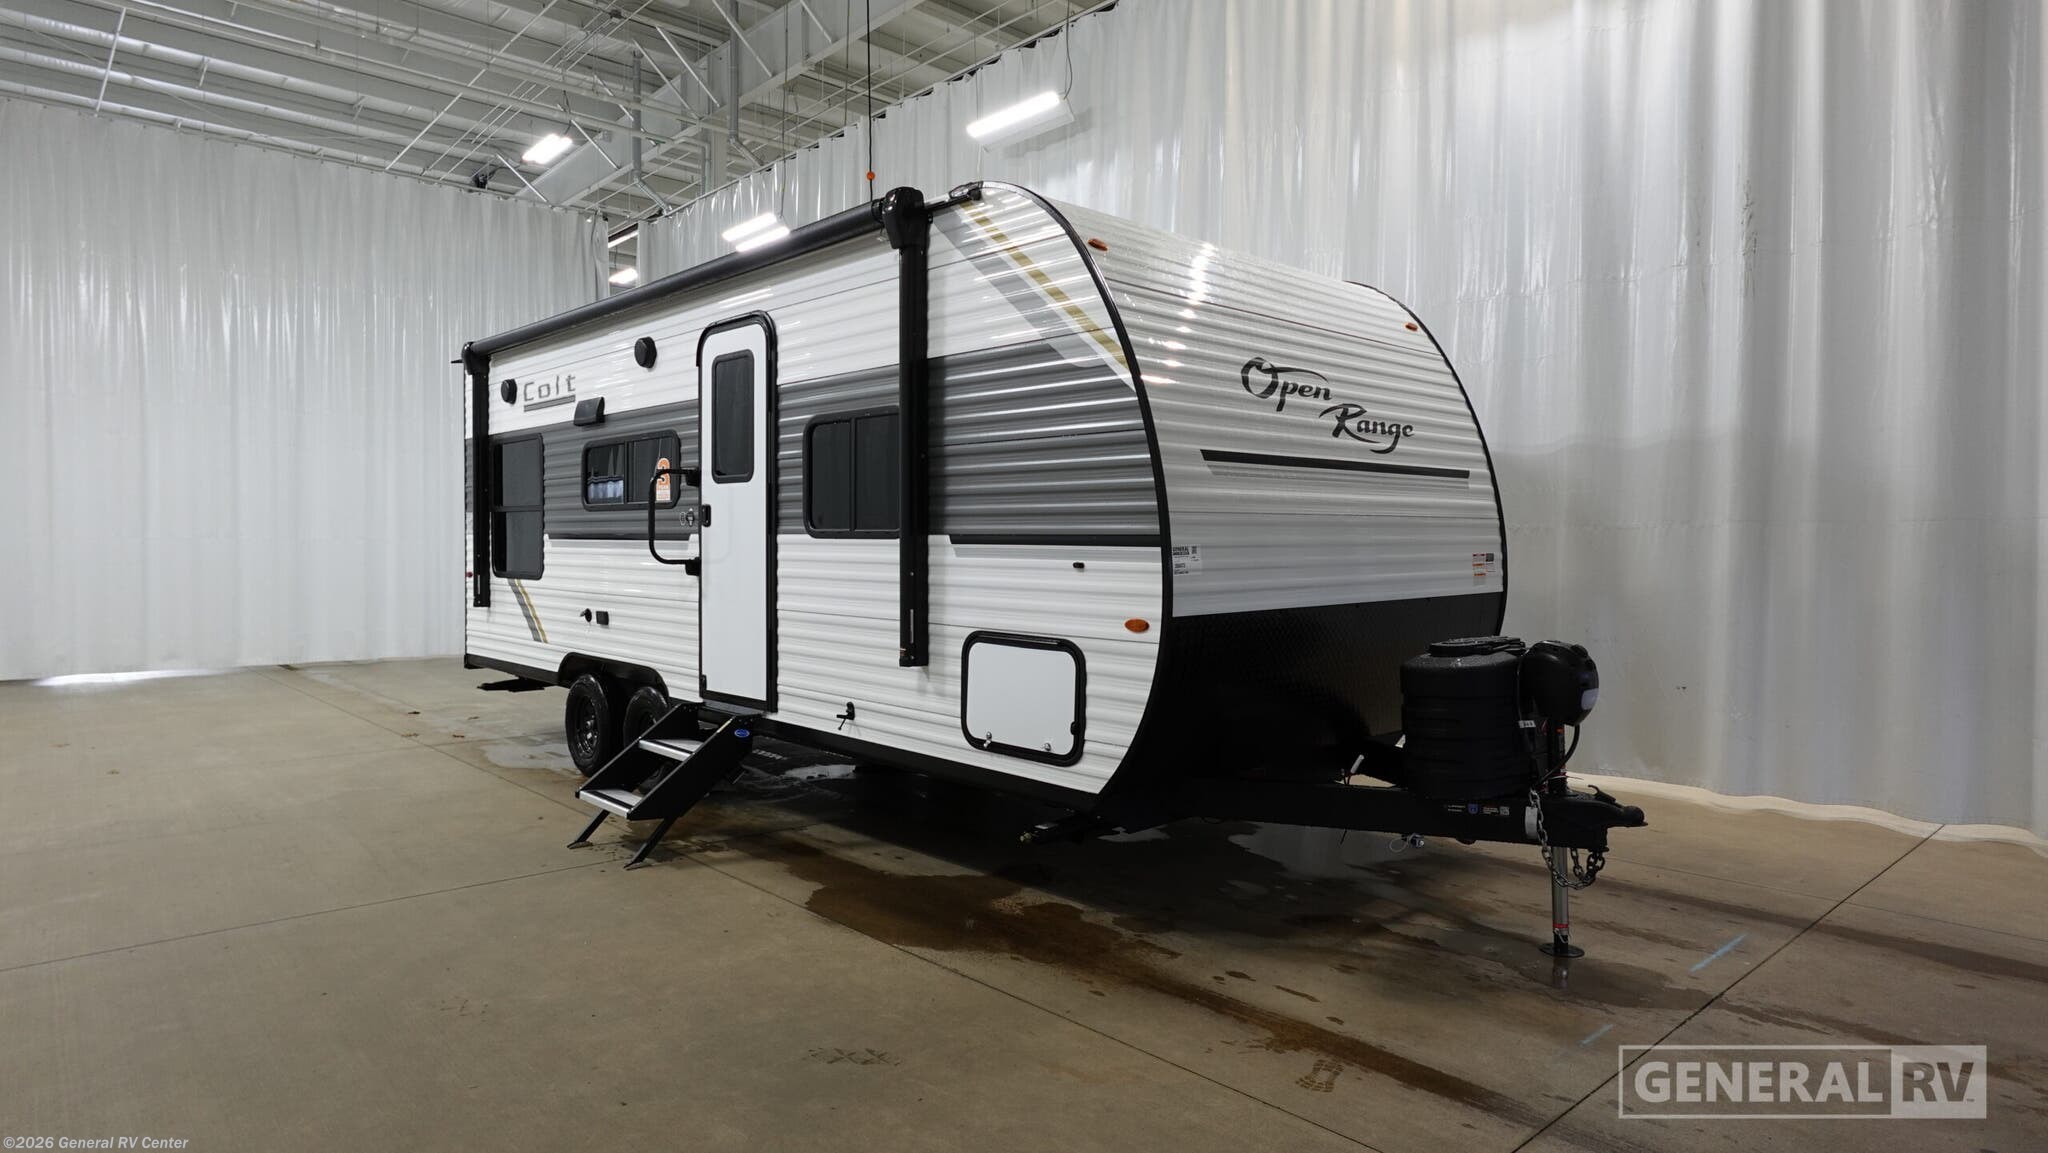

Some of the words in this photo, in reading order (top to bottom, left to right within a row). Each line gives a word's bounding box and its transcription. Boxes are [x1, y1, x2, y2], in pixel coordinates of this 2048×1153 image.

[523, 374, 576, 402] Colt
[1240, 357, 1332, 412] Open
[1318, 403, 1415, 454] Range
